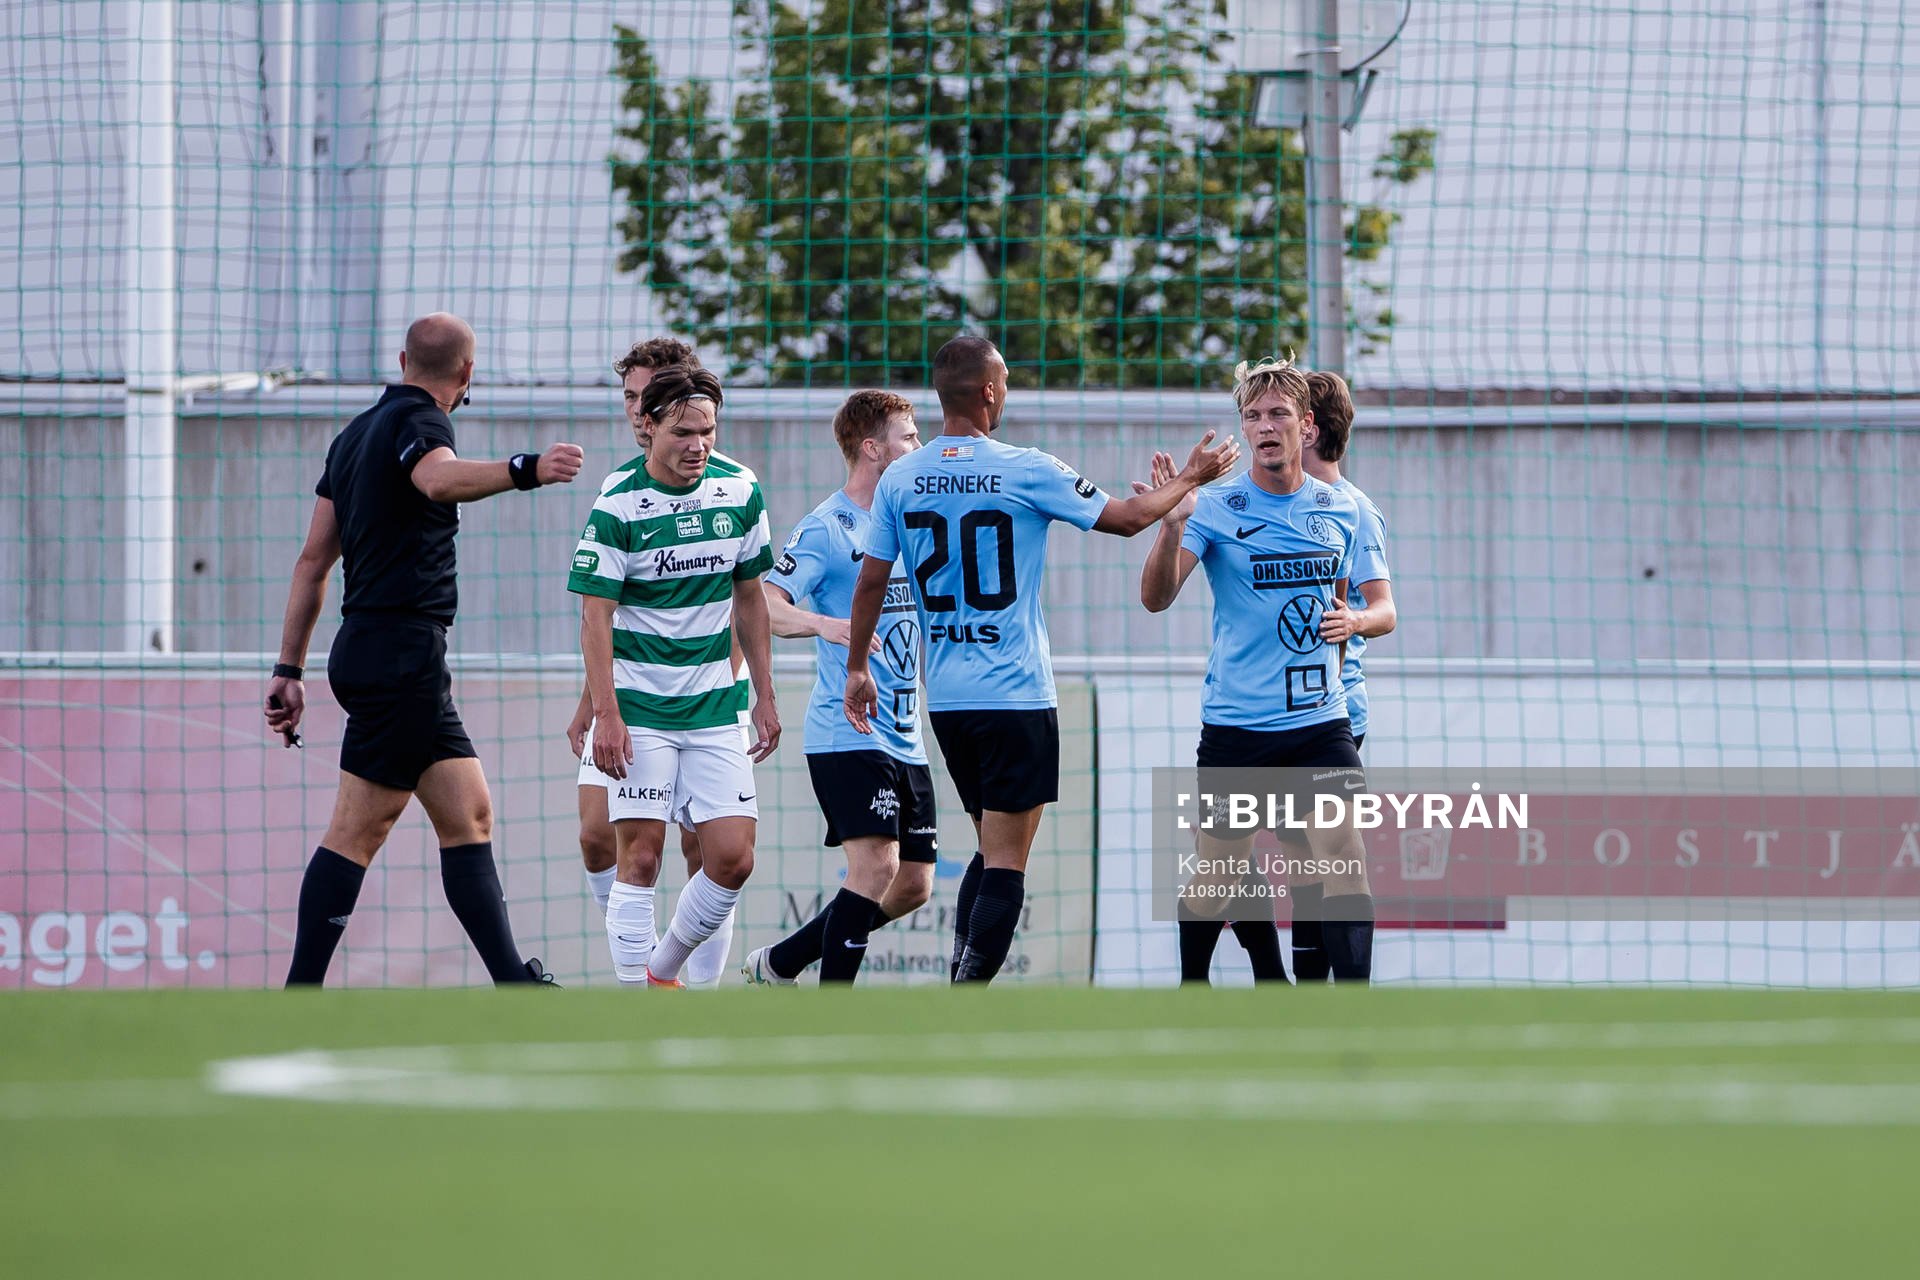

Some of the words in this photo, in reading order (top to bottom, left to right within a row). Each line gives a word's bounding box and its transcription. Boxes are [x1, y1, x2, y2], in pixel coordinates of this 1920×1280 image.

[914, 475, 1002, 495] SERNEKE
[679, 519, 691, 529] Bad
[654, 549, 732, 577] Kinnarps
[904, 509, 1018, 612] 20
[1253, 559, 1331, 580] OHLSSONS
[930, 624, 1001, 644] PULS
